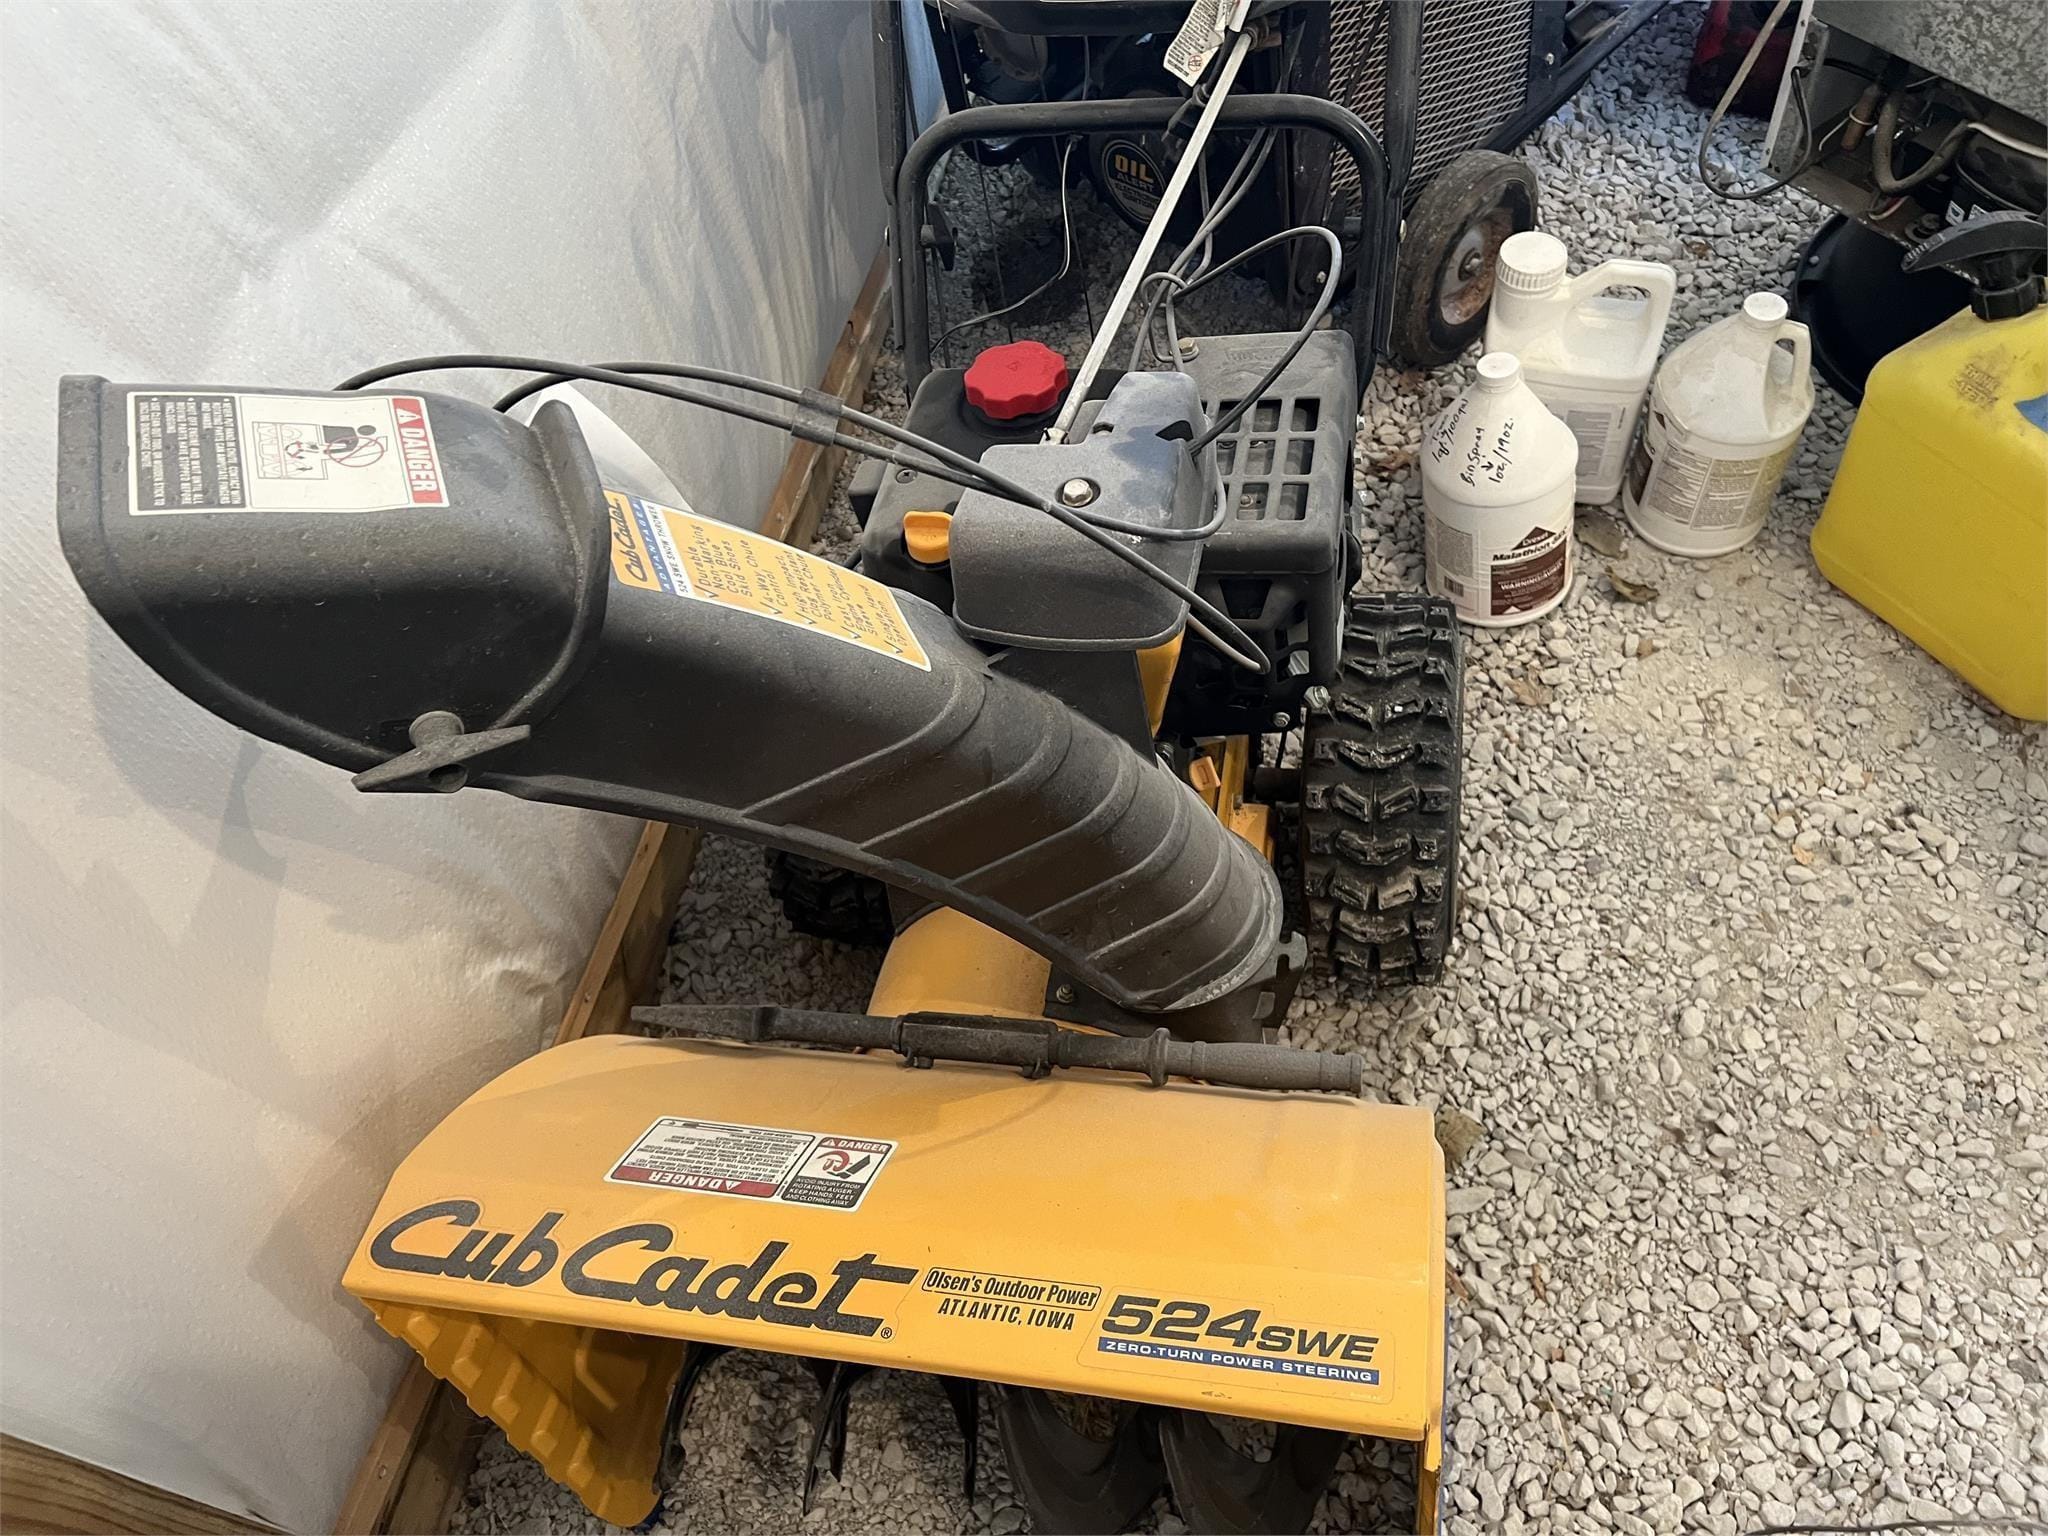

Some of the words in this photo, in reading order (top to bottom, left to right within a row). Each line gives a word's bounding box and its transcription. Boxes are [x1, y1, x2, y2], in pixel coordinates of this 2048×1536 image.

[1115, 154, 1154, 183] OIL
[400, 427, 438, 492] DANGER
[648, 506, 664, 536] THROWER
[662, 541, 675, 560] SNOW
[691, 525, 725, 590] Non-Marking
[723, 541, 740, 570] Shoes
[1493, 542, 1550, 561] Malathion
[619, 550, 647, 582] Cub
[671, 564, 682, 577] SWE
[687, 547, 712, 586] Durable
[677, 580, 688, 592] 524
[723, 570, 739, 593] Cool
[738, 574, 752, 597] Skid
[765, 570, 788, 607] Control
[838, 1140, 888, 1152] DANGER
[649, 1171, 723, 1189] DANGER
[793, 1183, 827, 1191] ROTATING
[800, 1195, 831, 1203] CLOTHING
[369, 1199, 560, 1288] Cub
[561, 1223, 919, 1338] Cadet
[926, 1270, 982, 1292] Olsen's
[984, 1277, 1046, 1300] Outdoor
[1046, 1285, 1098, 1307] Power
[938, 1298, 1022, 1326] ATLANTIC,
[1027, 1308, 1075, 1331] IOWA
[1106, 1341, 1205, 1361] ZERO-TURN
[1211, 1354, 1274, 1370] POWER
[1281, 1362, 1372, 1382] STEERING
